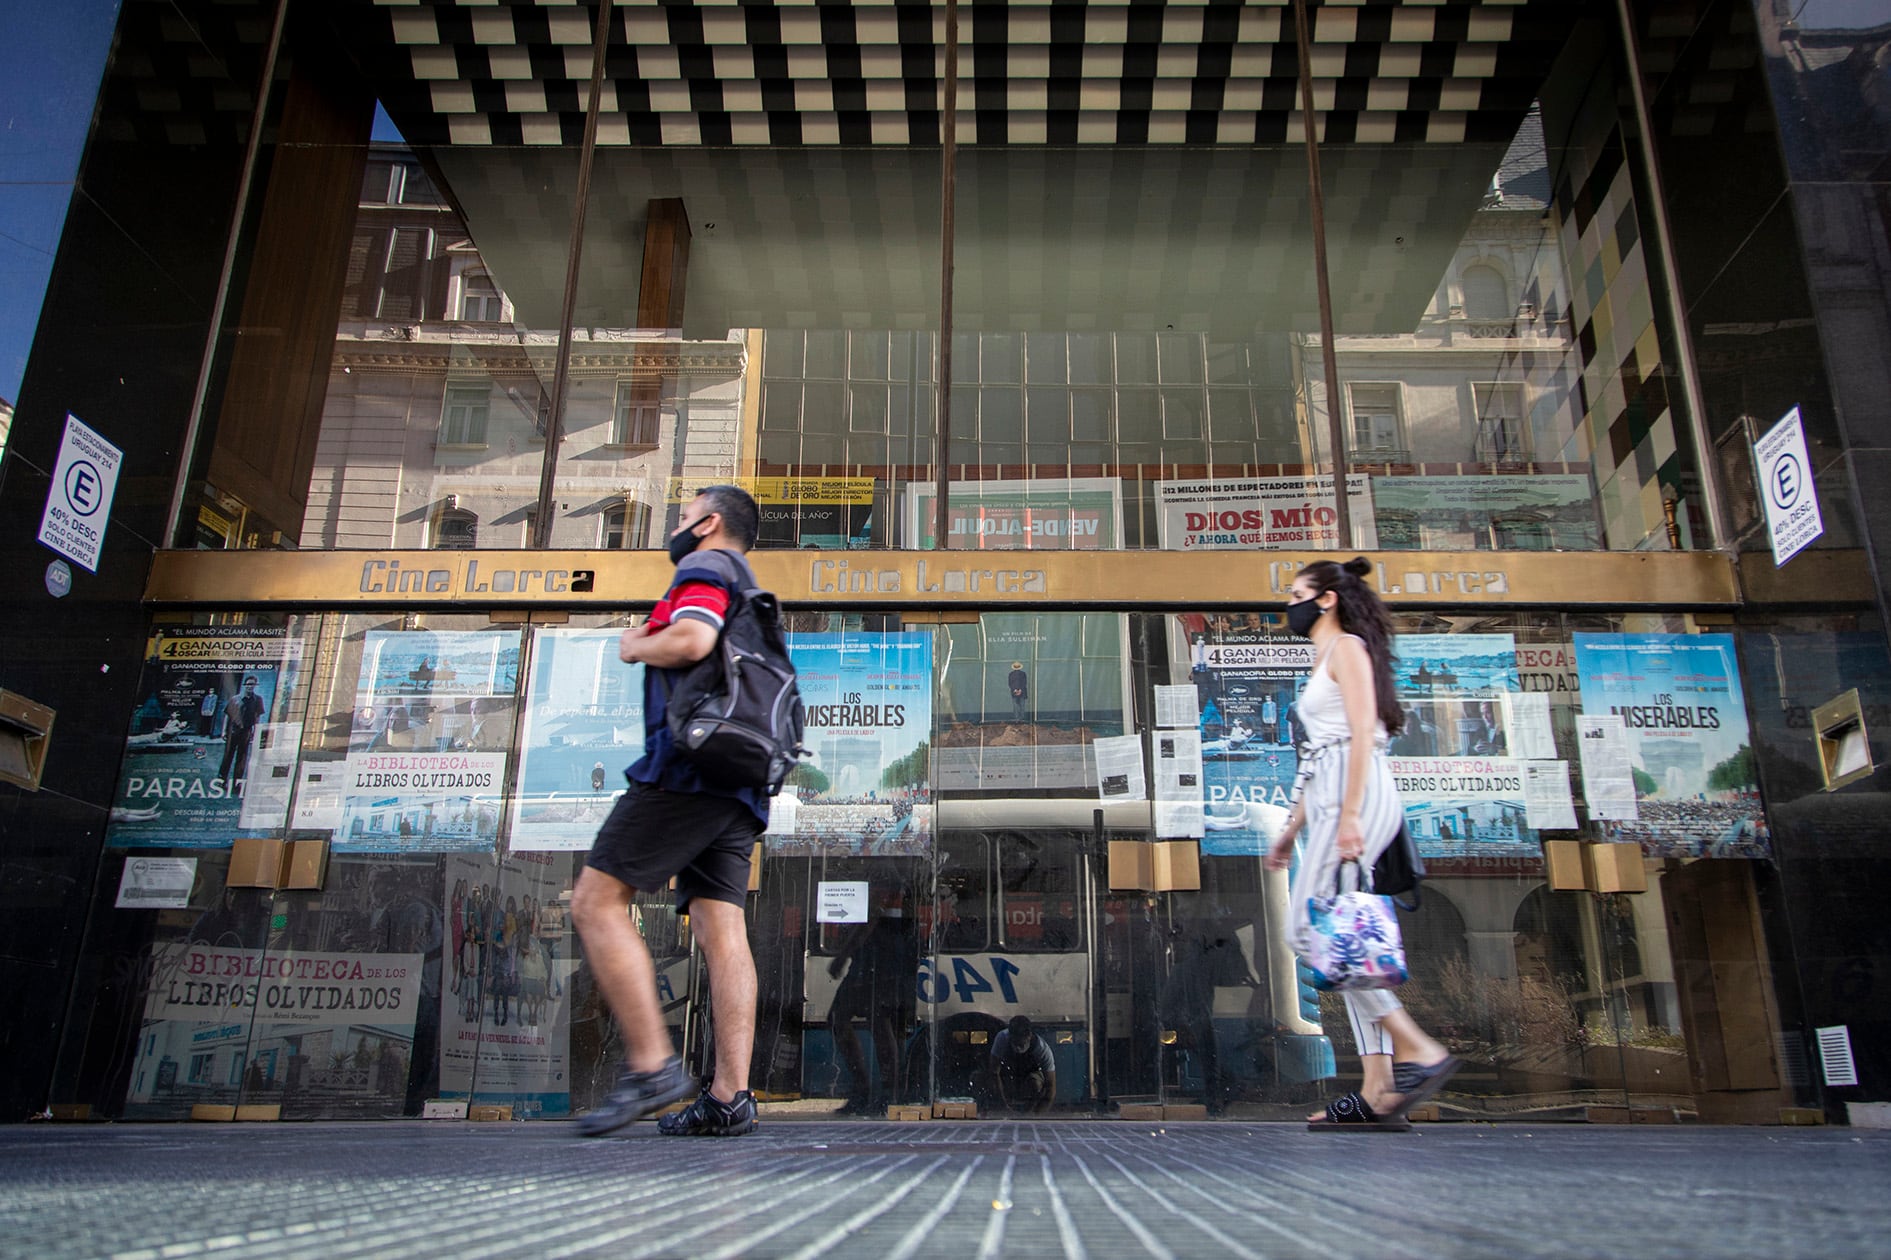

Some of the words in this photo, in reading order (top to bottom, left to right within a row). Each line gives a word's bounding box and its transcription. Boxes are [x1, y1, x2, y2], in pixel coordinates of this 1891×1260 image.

[69, 421, 83, 437] PLAYA
[83, 430, 119, 463] ESTACIONAMIENTO
[71, 436, 101, 464] URUGUAY
[101, 457, 112, 470] 214
[73, 469, 95, 508] E
[791, 485, 818, 493] GLOBO
[1177, 486, 1222, 494] MILLONES
[1224, 484, 1234, 492] DE
[1237, 482, 1304, 492] ESPECTADORES
[1306, 481, 1318, 489] EN
[1777, 462, 1795, 501] E
[802, 492, 820, 500] ORO
[760, 510, 789, 520] LÍCULA
[791, 511, 808, 520] DEL
[1184, 509, 1264, 532] DIOS
[1270, 502, 1337, 529] MÍO
[1789, 500, 1814, 525] DESC.
[50, 506, 70, 526] 40%
[71, 519, 99, 545] DESC.
[47, 520, 66, 538] SOLO
[66, 531, 96, 555] CLIENTES
[1184, 534, 1197, 547] ¿Y
[1198, 533, 1238, 545] AHORA
[1239, 531, 1262, 544] QUÉ
[1264, 531, 1304, 543] HEMOS
[1778, 541, 1795, 559] CINE
[1795, 524, 1818, 547] LORCA
[44, 530, 66, 549] CINE
[67, 543, 93, 566] LORCA
[50, 568, 69, 586] ADT
[359, 559, 451, 593] Cine
[465, 559, 596, 593] Lorca
[811, 559, 901, 593] Cine
[916, 559, 1047, 593] Lorca
[1376, 560, 1509, 594] Lorca
[185, 628, 217, 636] MUNDO
[217, 628, 249, 636] ACLAMA
[163, 641, 179, 657] 4
[180, 641, 264, 651] GANADORA
[234, 649, 265, 657] PELÍCULA
[1209, 649, 1222, 665] 4
[1223, 648, 1309, 657] GANADORA
[1223, 657, 1257, 665] OSCAR
[801, 683, 829, 692] SCARS
[843, 692, 862, 705] LOS
[1653, 693, 1673, 706] LOS
[611, 705, 621, 716] el
[802, 704, 906, 728] MISERABLES
[1611, 705, 1721, 729] MISERABLES
[368, 757, 470, 770] BIBLIOTECA
[1392, 761, 1494, 774] BIBLIOTECA
[126, 777, 247, 799] PARASIT
[355, 773, 408, 788] LIBROS
[412, 773, 492, 788] OLVIDADOS
[1394, 777, 1437, 792] IBROS
[1441, 777, 1521, 792] OLVIDADOS
[1207, 785, 1291, 806] PARA
[187, 952, 365, 981] BIBLIOTECA
[366, 968, 381, 978] DE
[385, 968, 406, 979] LOS
[166, 981, 258, 1008] LIBROS
[266, 984, 402, 1010] OLVIDADOS
